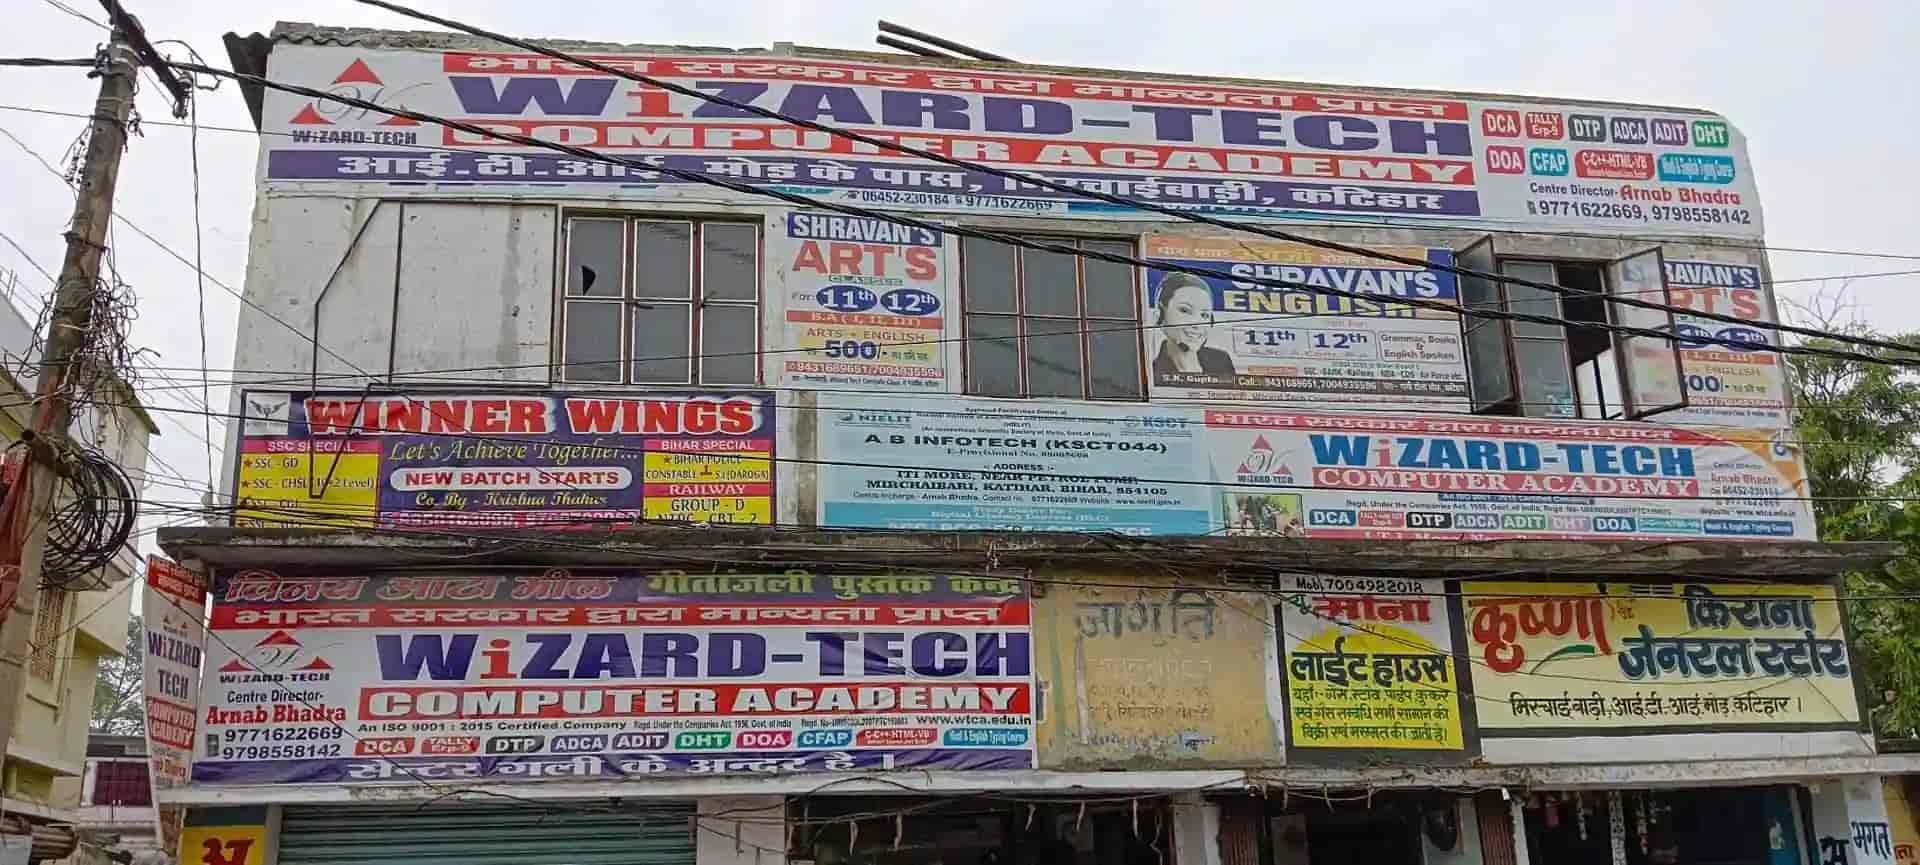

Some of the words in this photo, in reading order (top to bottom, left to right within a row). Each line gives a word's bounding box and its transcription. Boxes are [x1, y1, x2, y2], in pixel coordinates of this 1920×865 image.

[672, 62, 908, 84] सरकार
[1073, 84, 1299, 107] मान्यता
[1486, 114, 1518, 134] DCA
[1573, 118, 1601, 138] DTP
[1612, 120, 1648, 142] ADCA
[1653, 121, 1686, 143] ADIT
[1694, 122, 1727, 144] DHT
[451, 122, 1010, 161] COMPUTER
[1035, 143, 1467, 182] ACADEMY
[1490, 151, 1522, 171] DOA
[1531, 151, 1567, 172] CFAP
[808, 161, 856, 180] के
[1290, 186, 1445, 209] कटिहार
[1529, 182, 1568, 195] Centre
[1619, 185, 1673, 202] Arnab
[1678, 188, 1741, 206] Bhadra
[1540, 200, 1649, 224] 9771622669,
[1652, 206, 1751, 225] 9798558142
[793, 213, 936, 246] SHRAVAN'S
[791, 240, 938, 282] ART'S
[1231, 263, 1440, 297] SHRAVAN'S
[822, 289, 874, 309] 11th
[886, 293, 936, 312] 12th
[1223, 290, 1417, 318] ENGLISH
[863, 330, 926, 342] ENGLISH
[1244, 329, 1296, 346] 11th
[1312, 333, 1368, 349] 12th
[304, 398, 552, 435] WINNER
[566, 397, 760, 436] WINGS
[702, 440, 754, 451] SPECIAL
[864, 434, 881, 444] A
[889, 434, 905, 445] B
[913, 435, 1038, 449] INFOTECH
[1045, 440, 1168, 454] (KSCT044)
[1309, 433, 1696, 477] WiZARD-TECH
[405, 471, 454, 486] NEW
[460, 471, 530, 486] BATCH
[538, 471, 619, 485] STARTS
[668, 484, 746, 496] RAILWAY
[1316, 466, 1508, 490] COMPUTER
[1518, 475, 1693, 498] ACADEMY
[671, 498, 720, 512] GROUP
[735, 498, 745, 512] D
[1312, 512, 1351, 524] DCA
[1411, 514, 1446, 527] DTP
[1455, 514, 1498, 528] ADCA
[1503, 516, 1544, 529] ADIT
[1595, 518, 1632, 531] DOA
[235, 608, 377, 625] भारत
[388, 606, 574, 625] सरकार
[585, 605, 685, 625] द्वारा
[700, 606, 877, 624] मान्यता
[890, 606, 1001, 625] प्राप्त
[1311, 595, 1432, 622] सोना
[1685, 583, 1818, 632] किराना
[375, 631, 1032, 682] WiZARD-TECH
[1290, 637, 1369, 688] लाईट
[1372, 653, 1449, 689] हाउस
[1617, 622, 1753, 680] जेनरल
[1753, 629, 1851, 681] स्टोर
[157, 669, 189, 699] TECH
[226, 690, 268, 704] Centre
[206, 704, 269, 725] Arnab
[272, 703, 347, 723] Bhadra
[367, 687, 717, 719] COMPUTER
[730, 686, 1019, 713] ACADEMY
[224, 726, 344, 743] 9771622669
[357, 723, 377, 733] An
[382, 723, 408, 732] ISO
[460, 722, 493, 731] 2015
[497, 721, 559, 731] Certified
[562, 720, 627, 732] Company
[915, 714, 1032, 726] www.wtca.edu.in
[223, 743, 342, 760] 9798558142
[365, 740, 408, 753] DCA
[495, 737, 536, 751] DTP
[554, 736, 602, 750] ADCA
[616, 735, 665, 748] ADIT
[680, 734, 728, 747] DHT
[742, 734, 786, 746] DOA
[801, 731, 851, 745] CFAP
[495, 754, 603, 777] गली
[621, 750, 668, 773] के
